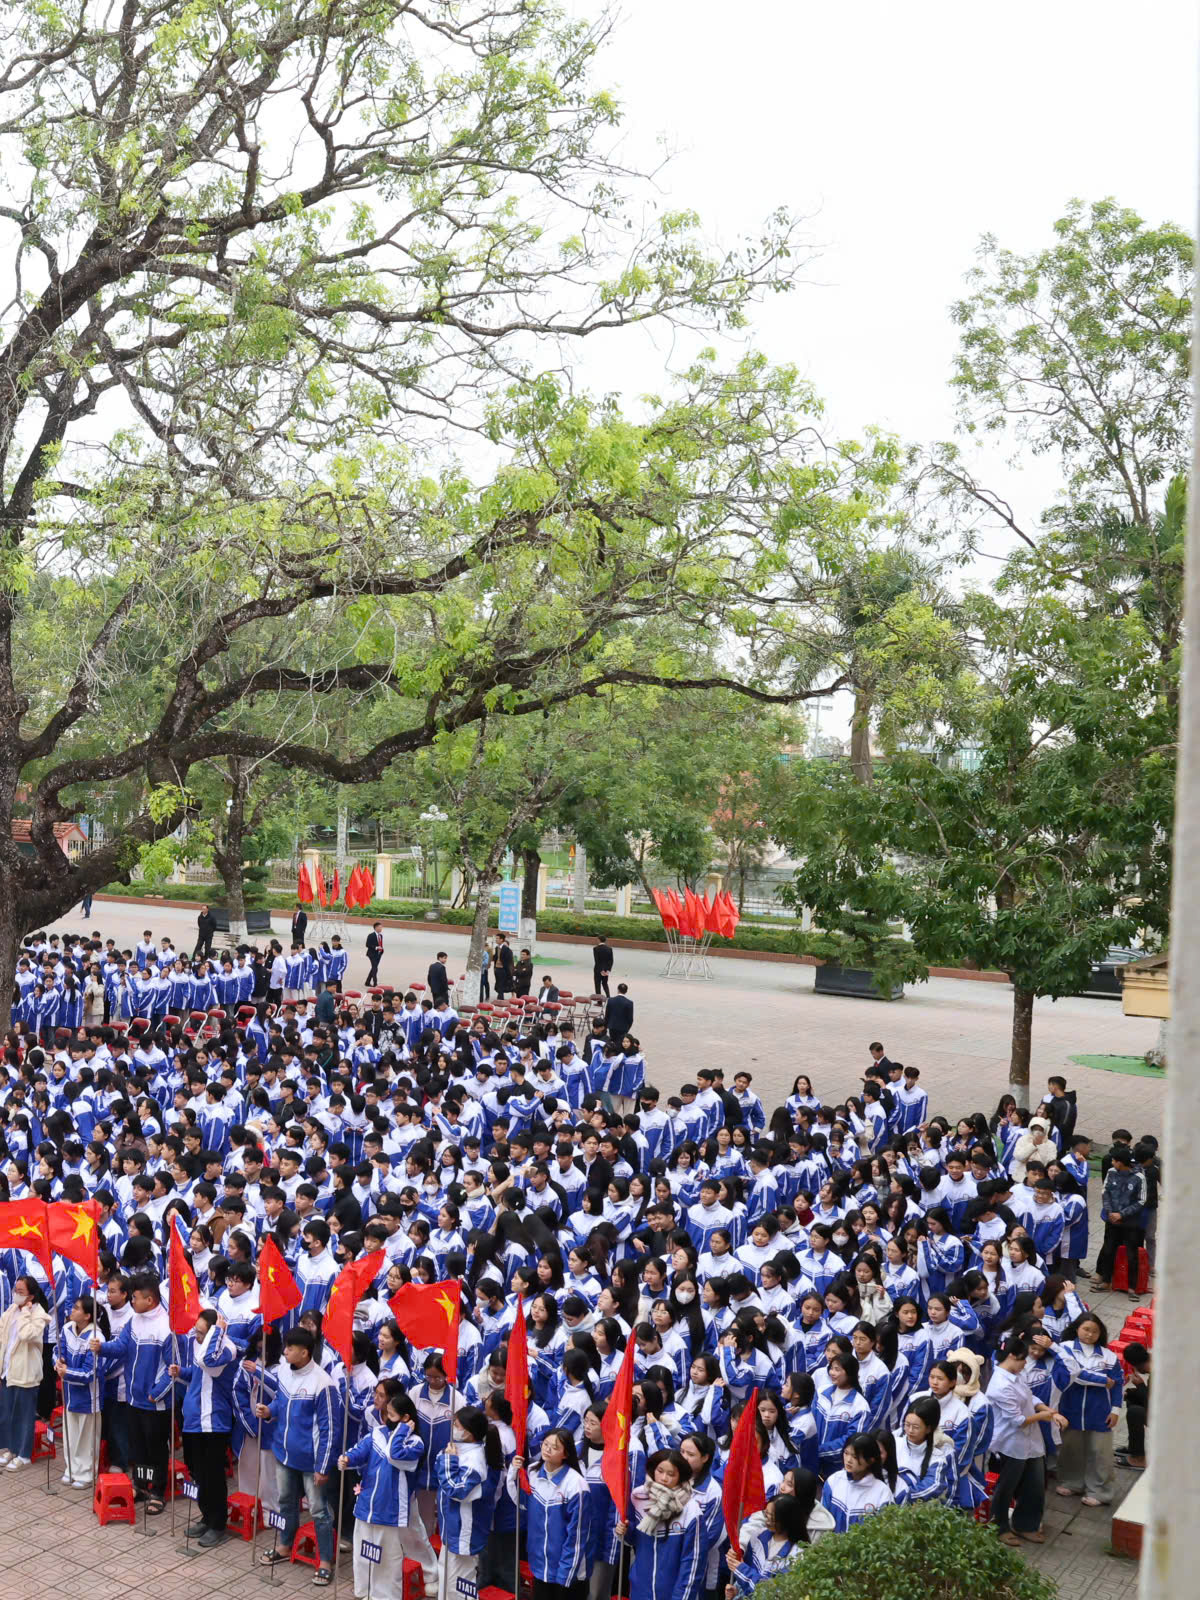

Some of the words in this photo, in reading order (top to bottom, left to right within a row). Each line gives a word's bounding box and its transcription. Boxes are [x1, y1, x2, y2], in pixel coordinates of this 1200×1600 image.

[137, 1467, 144, 1479] 11
[146, 1468, 154, 1481] A7
[362, 1543, 380, 1561] 11A10
[458, 1580, 476, 1596] 11A11
